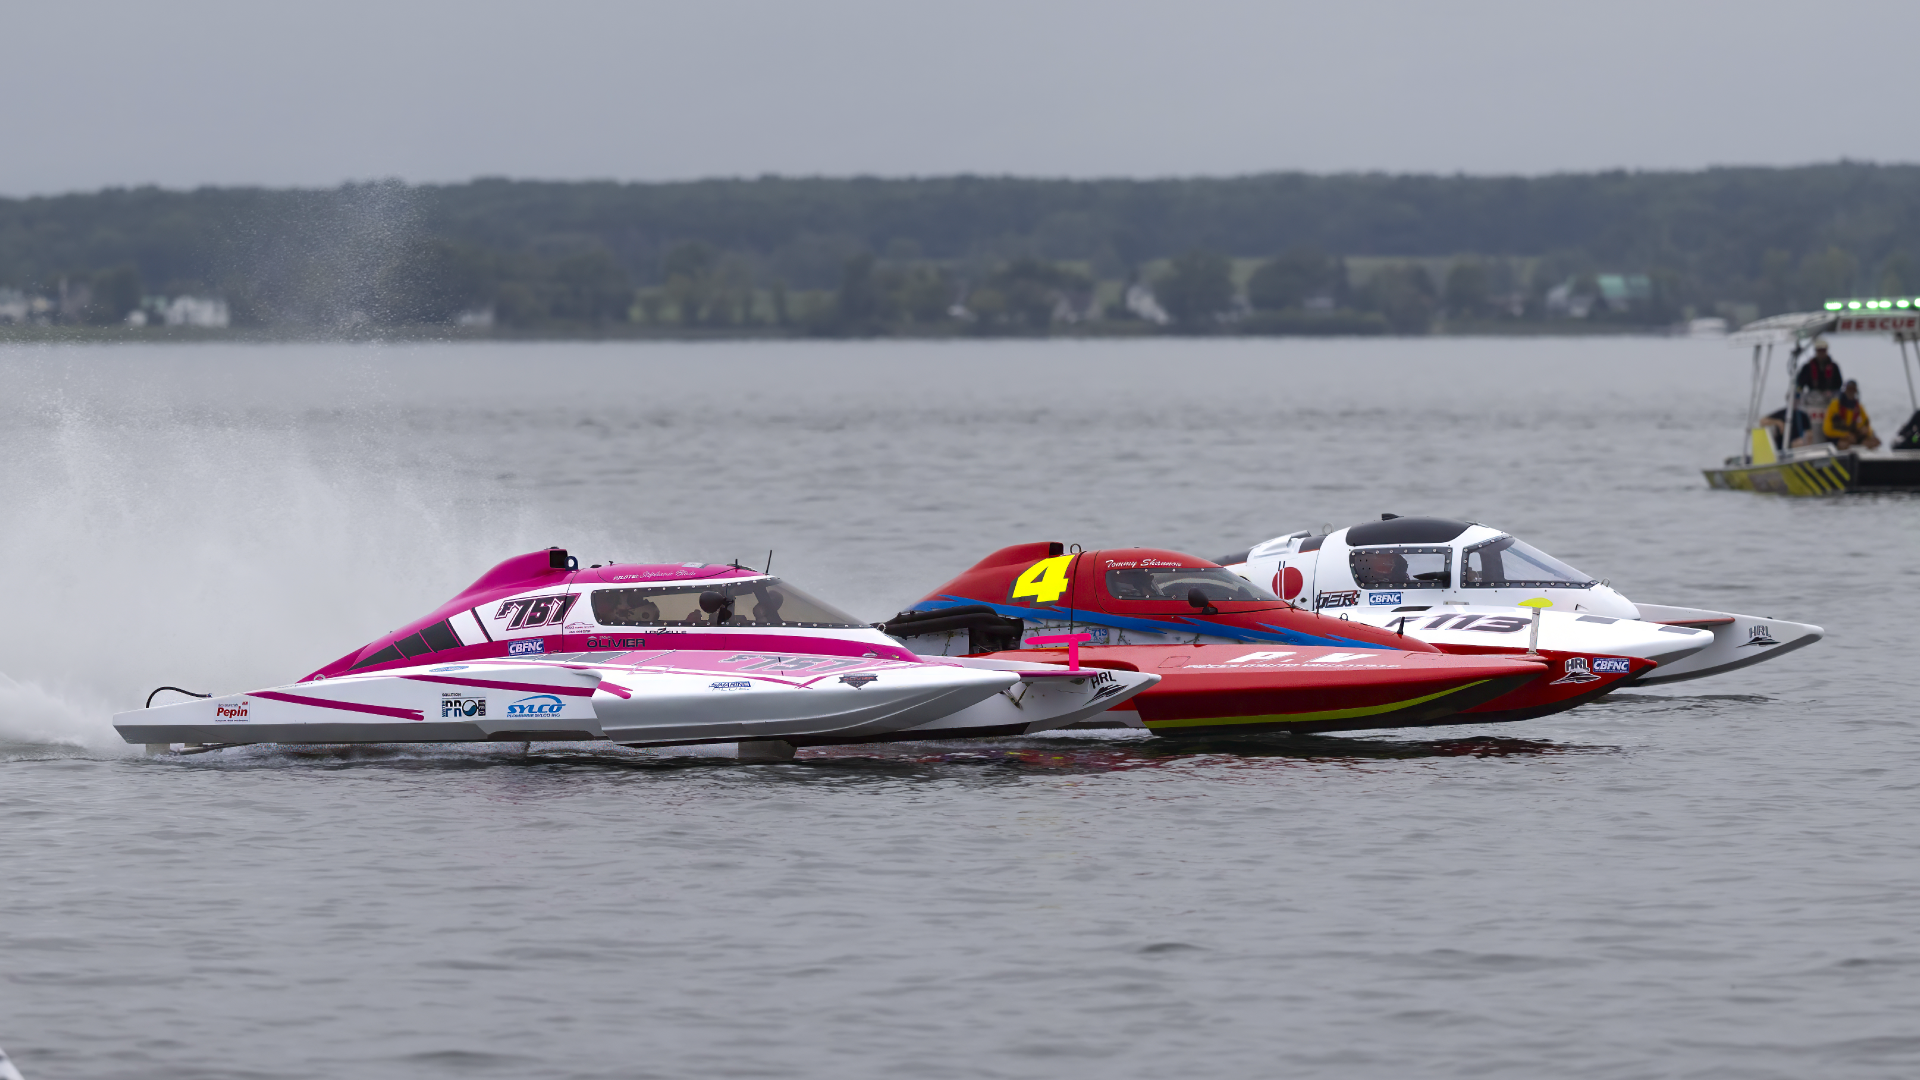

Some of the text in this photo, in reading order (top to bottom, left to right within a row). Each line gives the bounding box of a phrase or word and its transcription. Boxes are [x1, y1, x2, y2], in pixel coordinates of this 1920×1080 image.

[1840, 317, 1917, 331] RESCUE
[1105, 558, 1182, 569] Tommy Shannon
[1010, 554, 1076, 604] 4
[1370, 593, 1401, 604] CBFNC
[1749, 624, 1772, 639] HRL
[509, 641, 543, 654] CBFNC
[1565, 657, 1590, 673] HRL
[1593, 660, 1629, 671] CBFNC
[1091, 671, 1117, 689] HRL
[216, 705, 248, 718] Pepin
[507, 704, 566, 714] SYLCO
